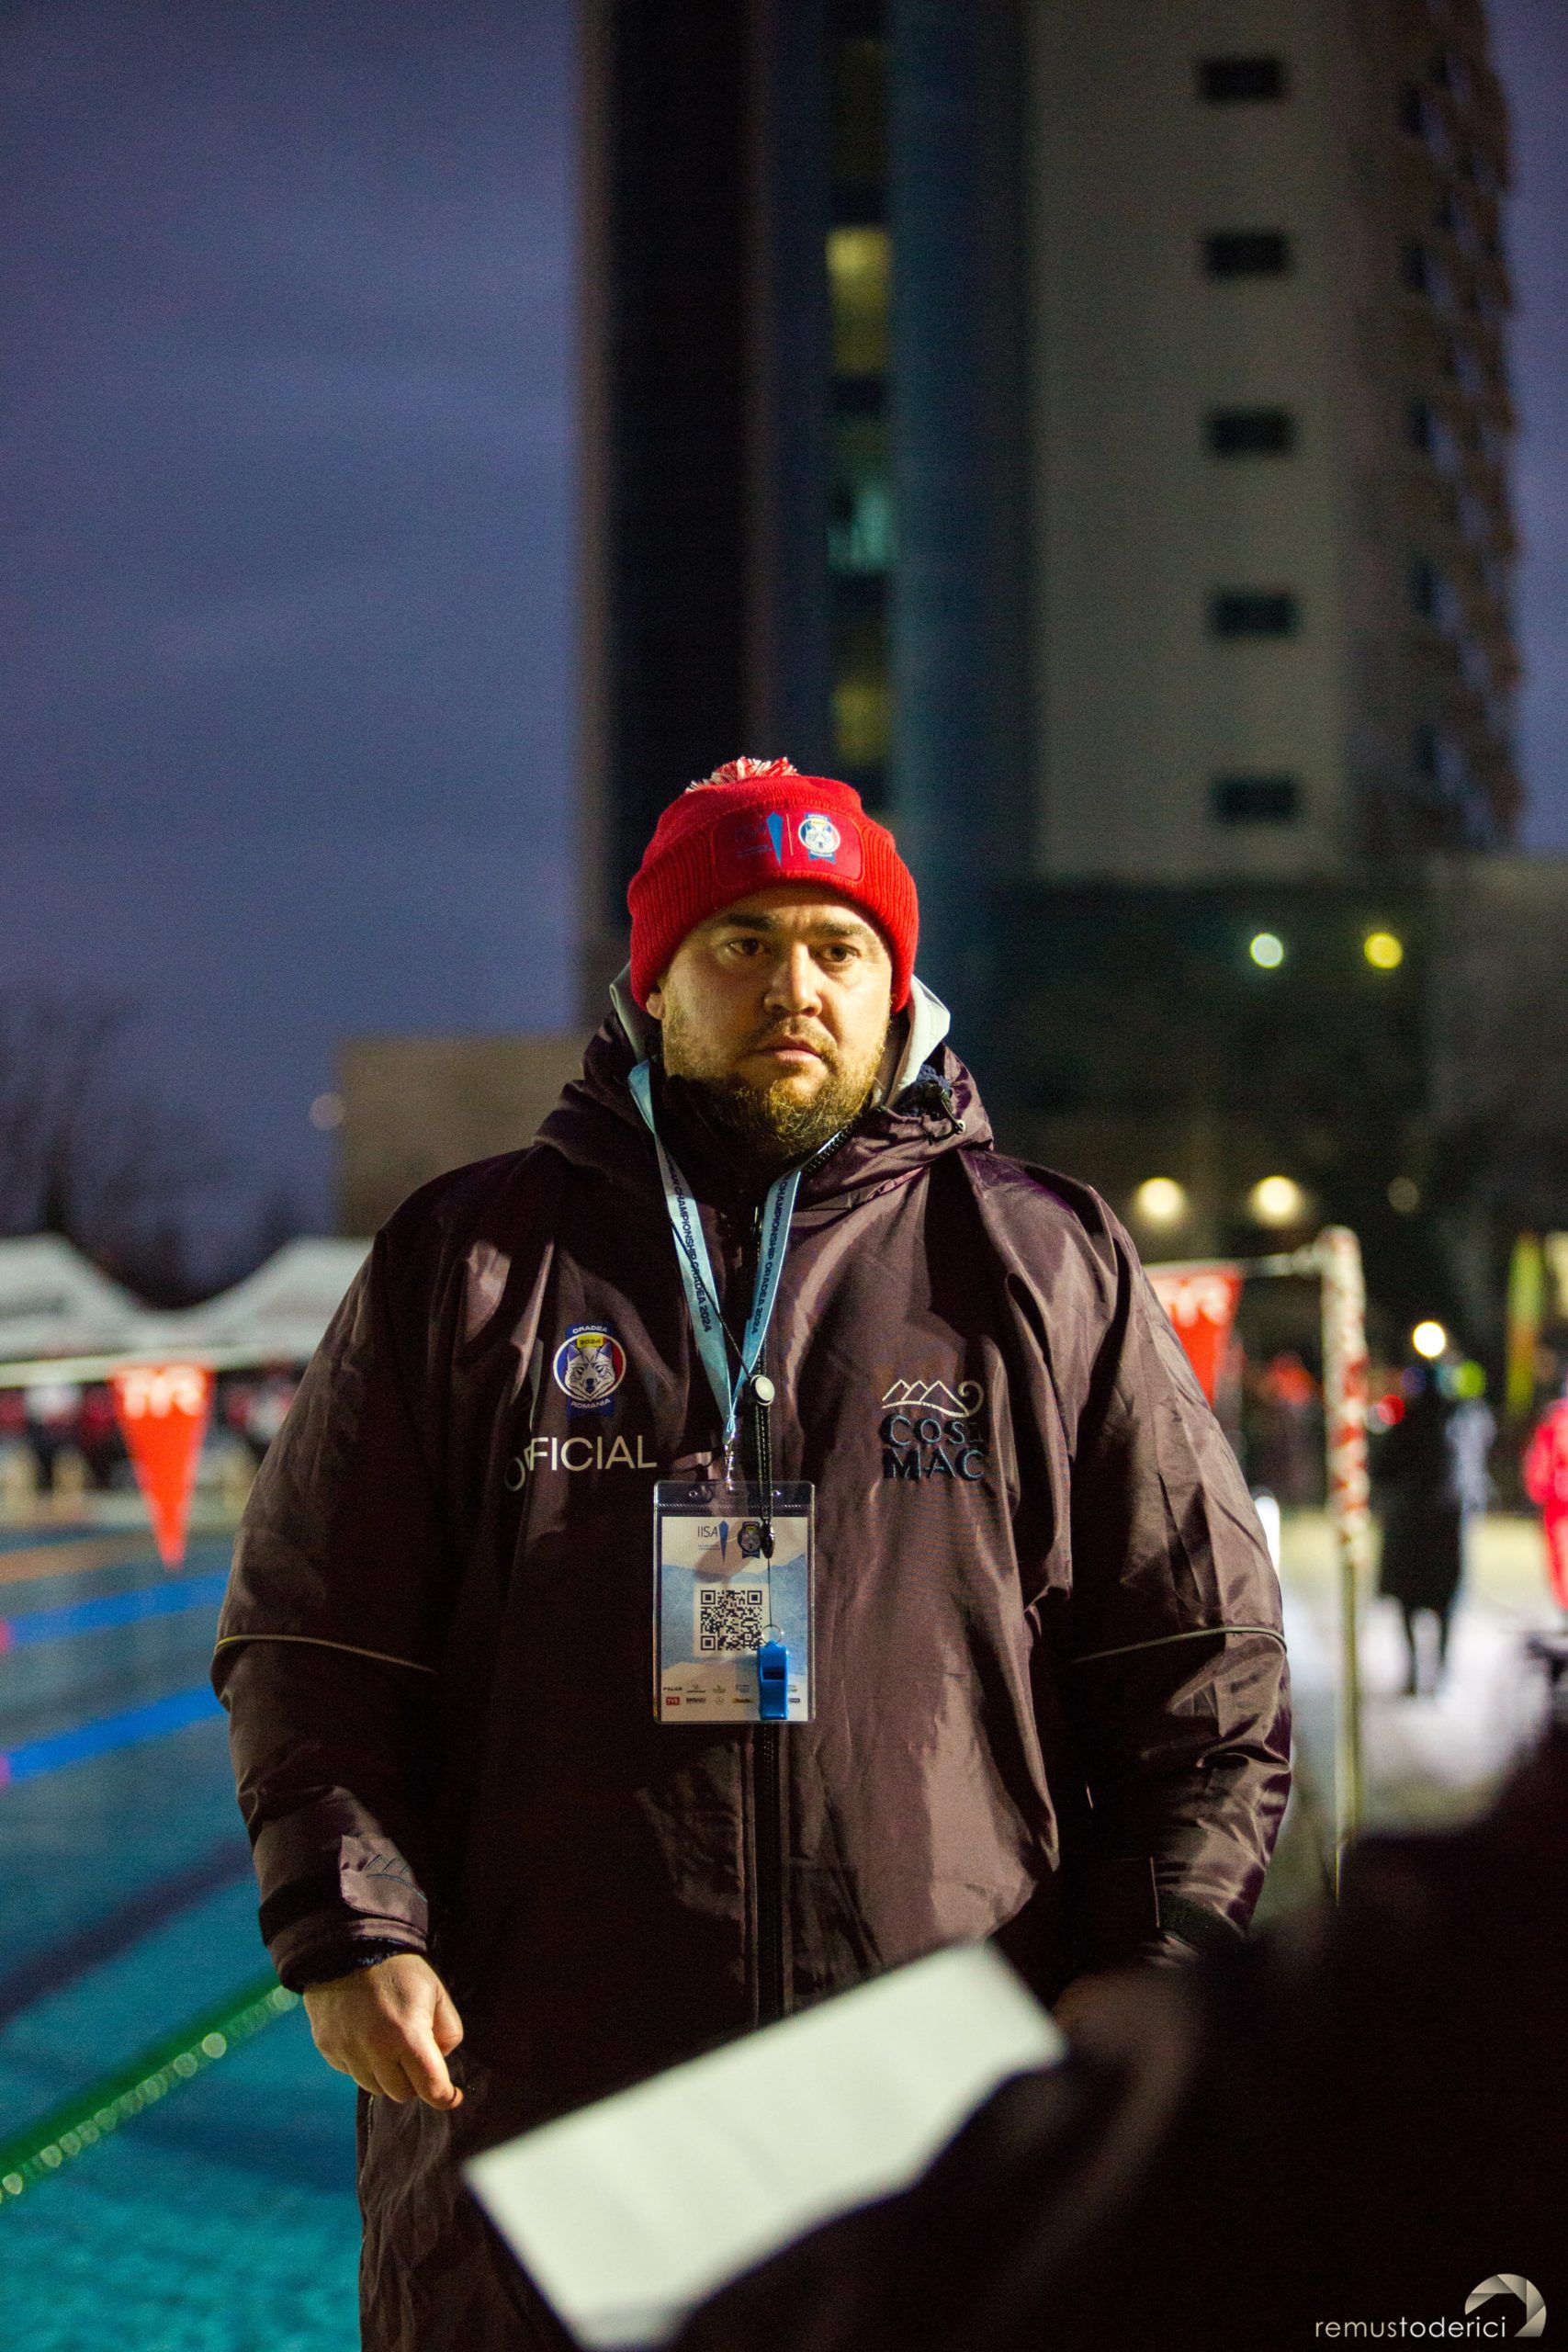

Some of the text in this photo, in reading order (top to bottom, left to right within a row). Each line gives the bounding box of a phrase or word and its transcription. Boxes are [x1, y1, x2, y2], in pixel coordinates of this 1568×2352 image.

[767, 1182, 788, 1260] CHAMPIONSHIP
[674, 1185, 697, 1263] CHAMPIONSHIP
[699, 1307, 712, 1333] 2024
[757, 1261, 773, 1306] ORADEA
[572, 1324, 608, 1334] ORADEA
[751, 1308, 762, 1335] 2024
[579, 1337, 603, 1345] 2024
[570, 1398, 611, 1410] ROMANIA
[881, 1446, 986, 1482] MAC
[697, 1525, 718, 1538] IISA
